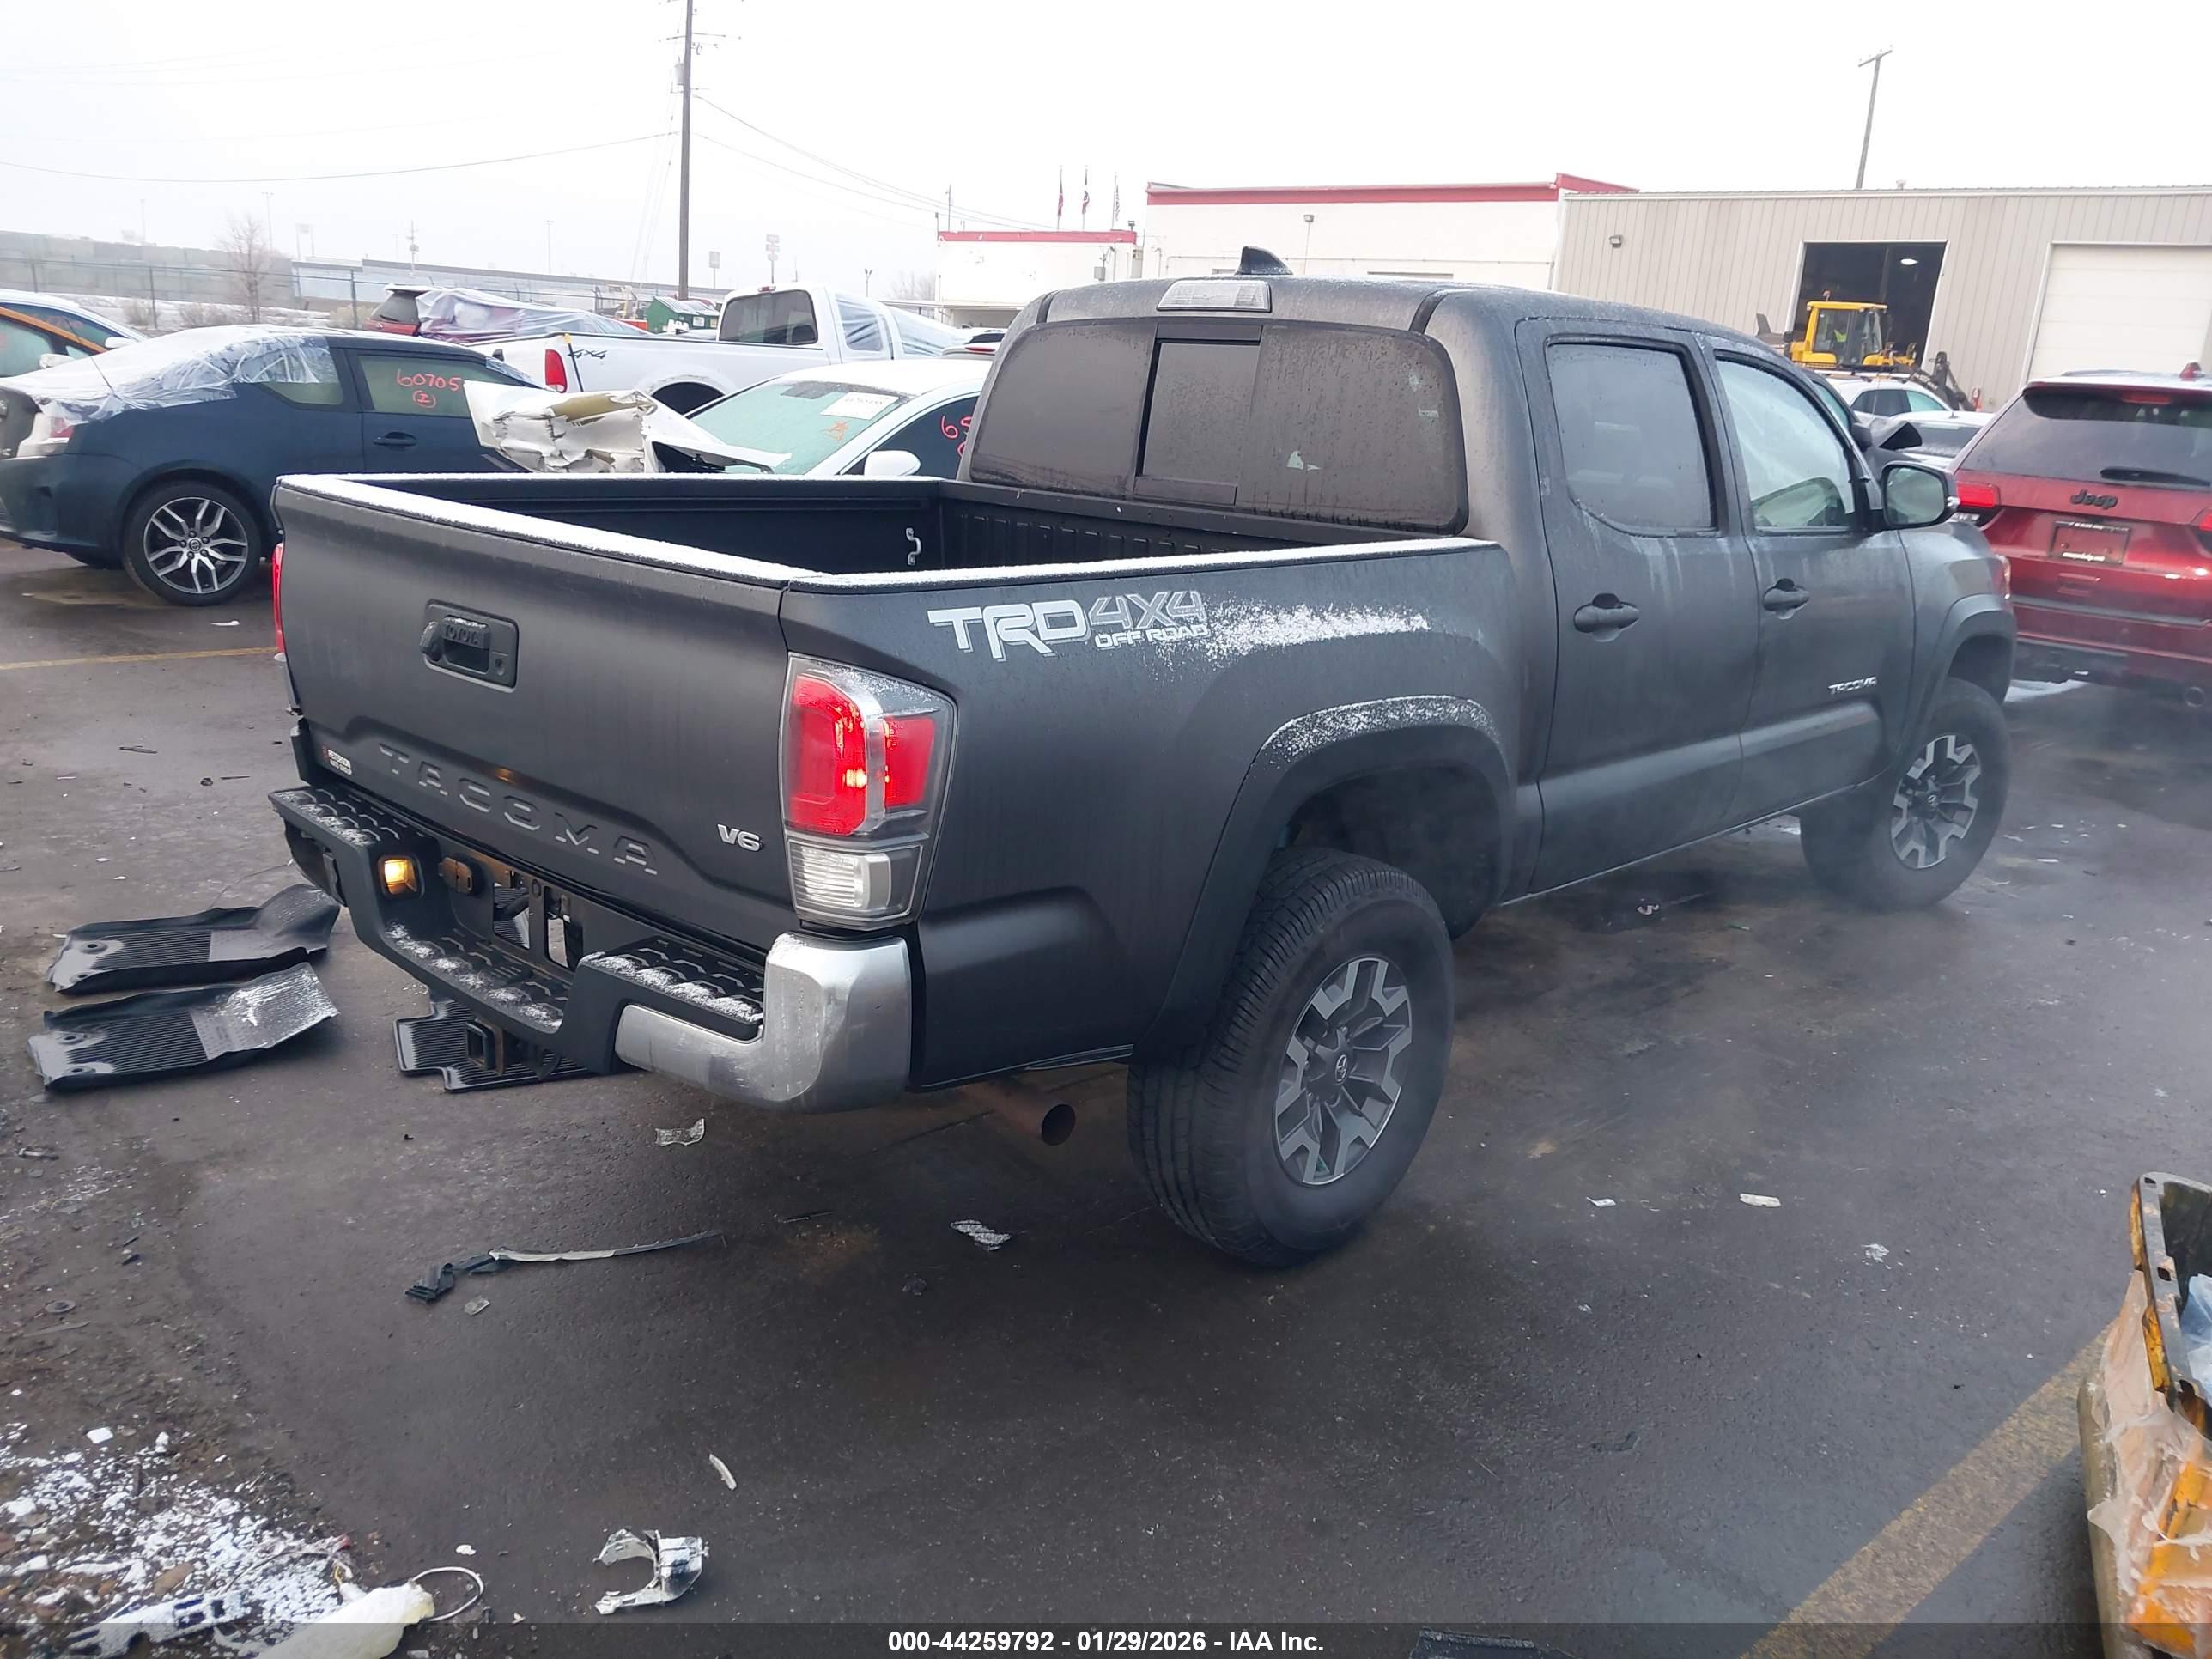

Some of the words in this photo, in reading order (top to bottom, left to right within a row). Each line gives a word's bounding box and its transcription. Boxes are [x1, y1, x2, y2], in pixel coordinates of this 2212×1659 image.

[397, 368, 462, 391] 60705
[2070, 489, 2118, 510] Jeep
[927, 599, 1091, 662] TRD
[1088, 591, 1207, 629] 4X4
[1095, 630, 1144, 649] OFF
[1146, 623, 1211, 643] ROAD
[1828, 677, 1876, 695] TACOMA
[379, 743, 658, 876] TACOMA
[717, 823, 761, 852] V6
